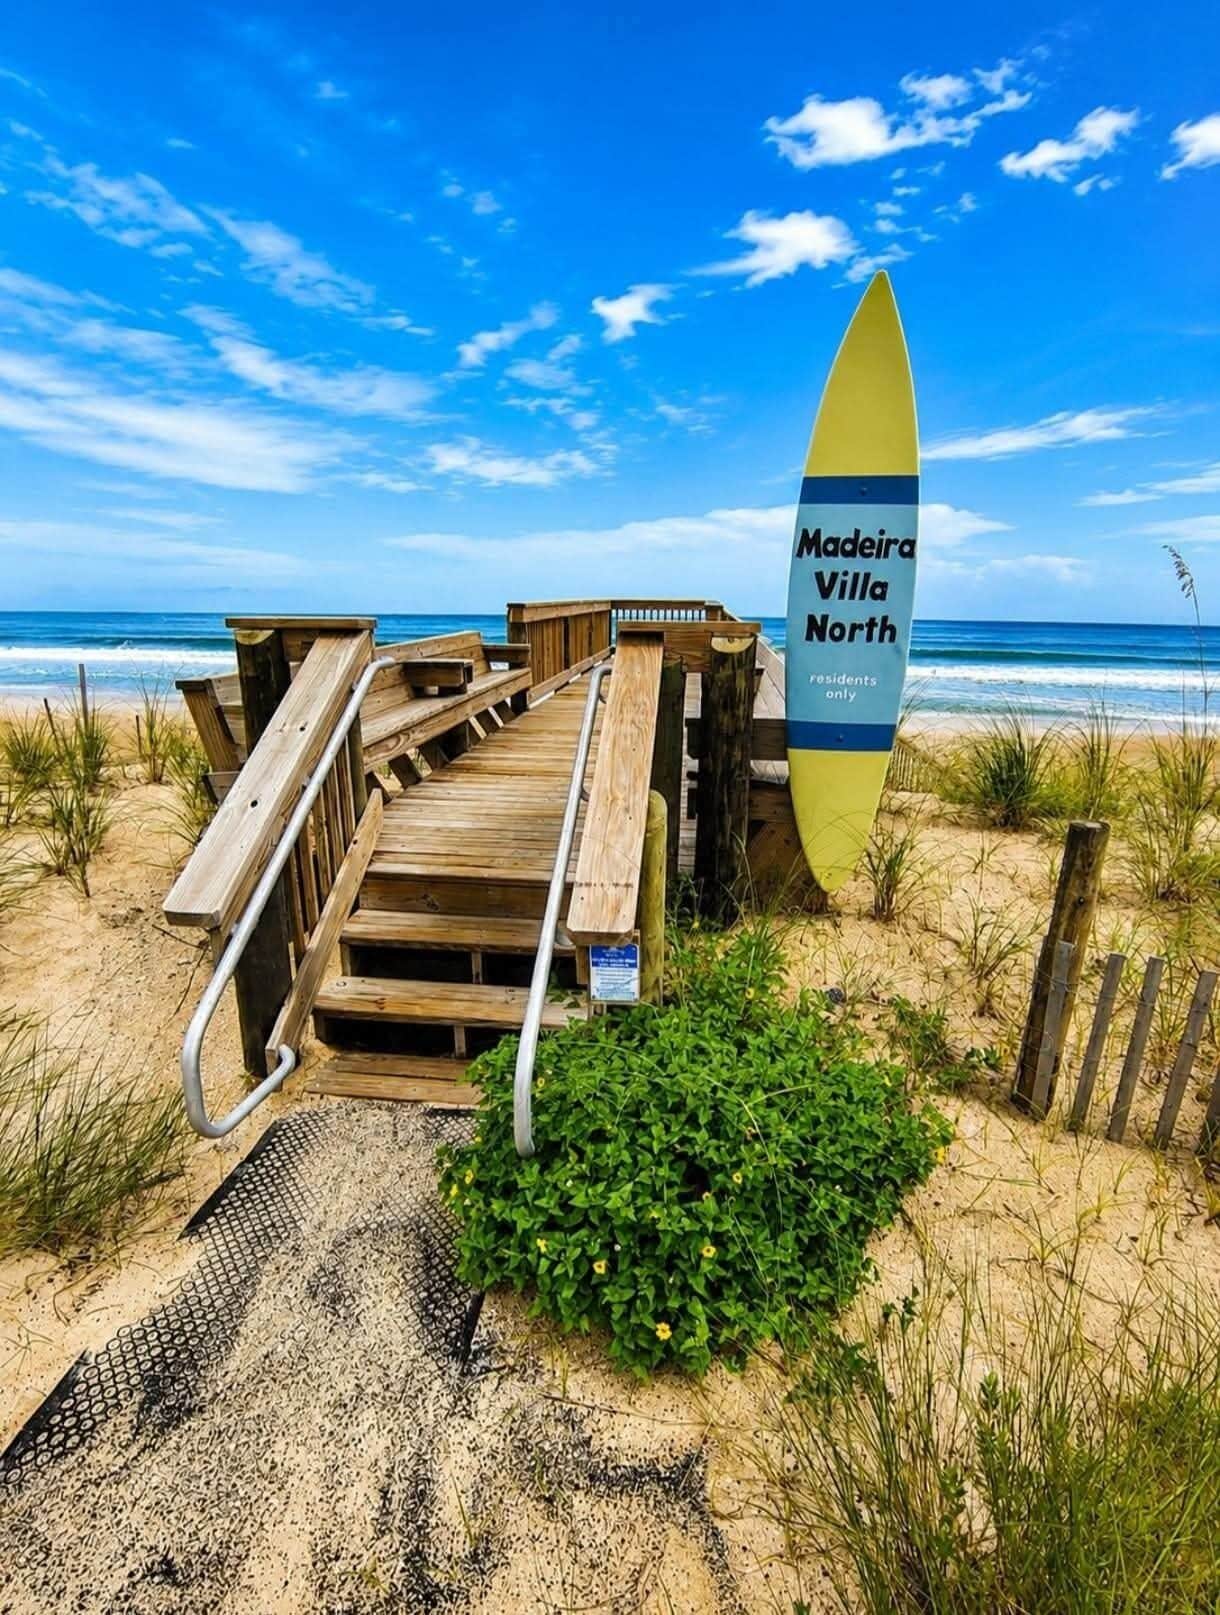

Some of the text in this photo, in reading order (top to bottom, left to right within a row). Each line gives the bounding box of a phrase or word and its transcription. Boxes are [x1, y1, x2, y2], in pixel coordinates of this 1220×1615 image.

[796, 527, 916, 559] Madeira
[814, 570, 889, 601] Villa
[805, 614, 897, 643] North
[808, 673, 877, 686] residents
[825, 689, 857, 703] only
